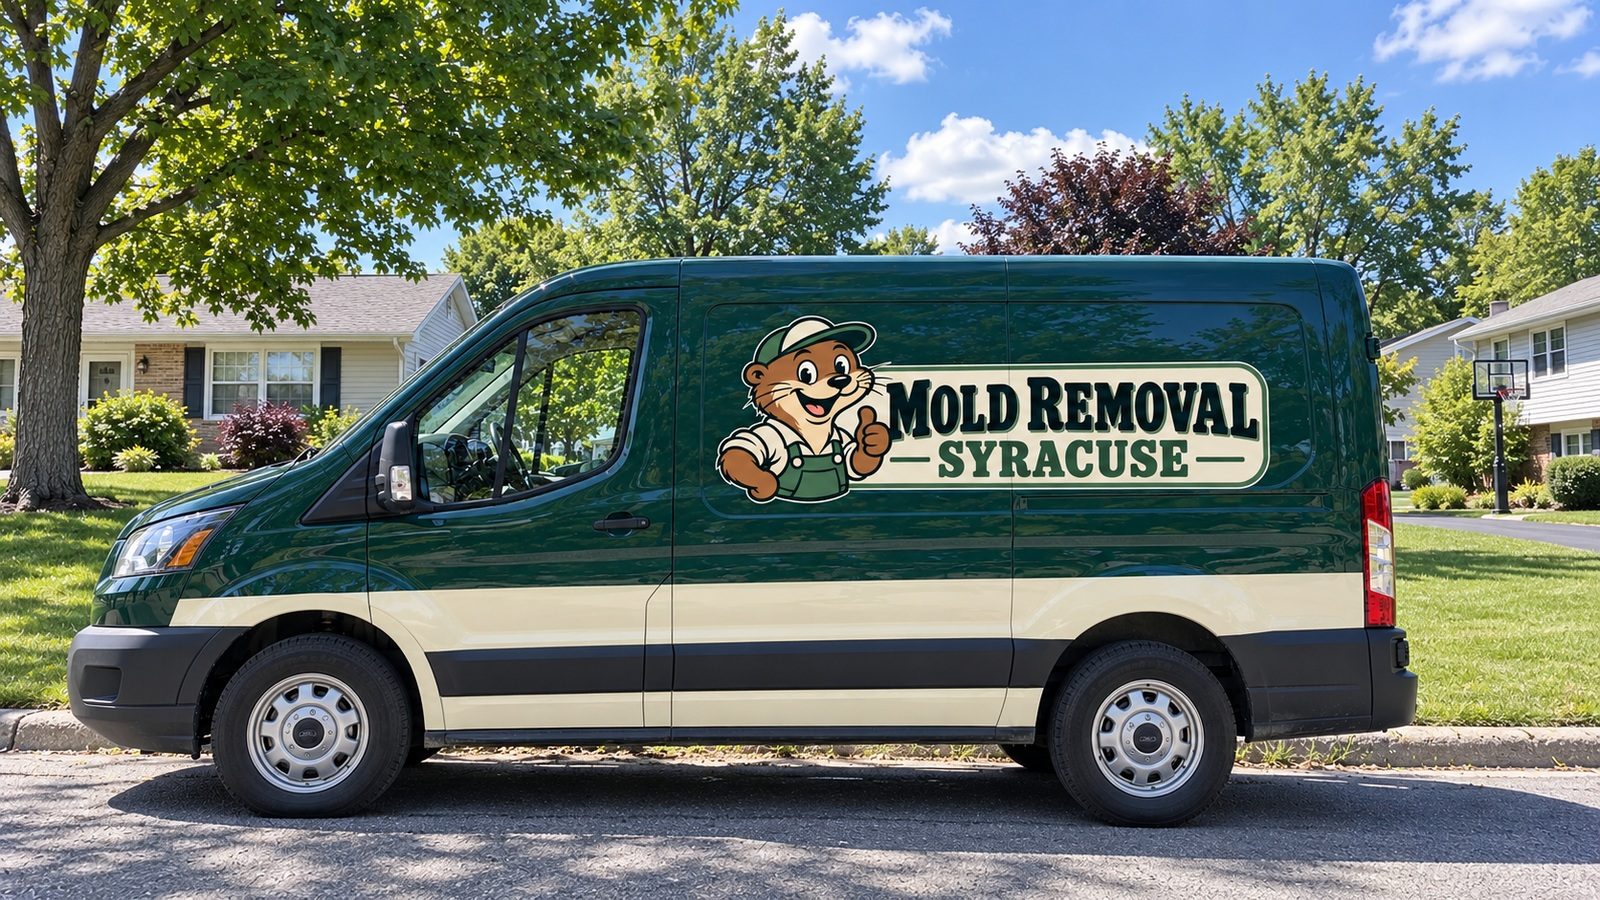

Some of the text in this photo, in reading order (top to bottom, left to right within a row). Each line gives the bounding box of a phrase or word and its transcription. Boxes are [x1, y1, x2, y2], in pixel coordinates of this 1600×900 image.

[886, 377, 1259, 440] MOLD REMOVAL
[938, 440, 1188, 478] SYRACUSE
